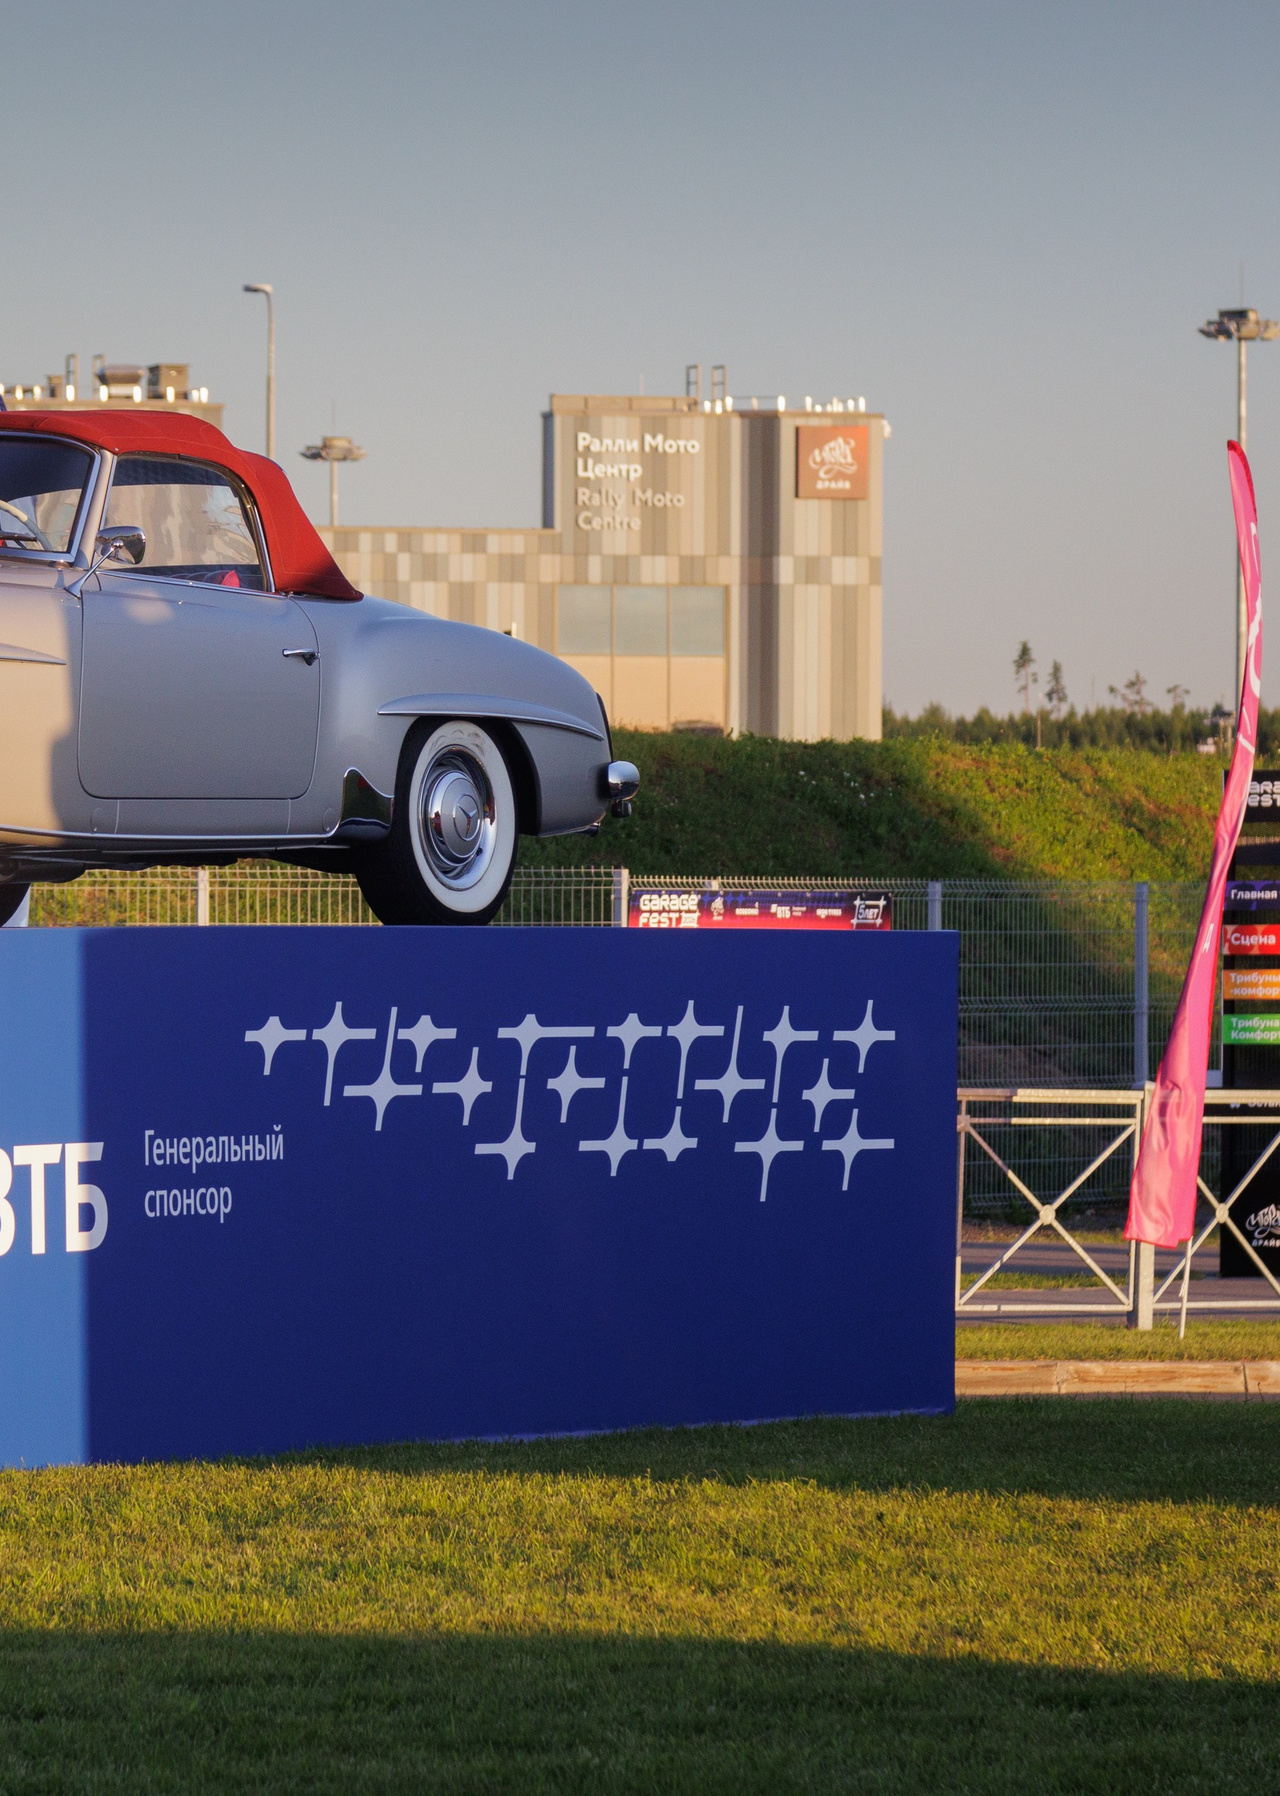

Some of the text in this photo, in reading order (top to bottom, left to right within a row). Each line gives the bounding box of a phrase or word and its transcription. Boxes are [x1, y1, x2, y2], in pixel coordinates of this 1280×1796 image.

[576, 431, 700, 454] Ралли Мото
[576, 457, 643, 482] Центр
[576, 487, 685, 510] Rally Moto
[576, 510, 642, 531] Centre
[1230, 889, 1278, 900] Главная
[1230, 932, 1276, 946] Сцена
[1230, 985, 1280, 998] -комфор
[1231, 1017, 1280, 1029] Трибуна
[143, 1124, 285, 1174] Генеральный
[143, 1184, 234, 1224] спонсор
